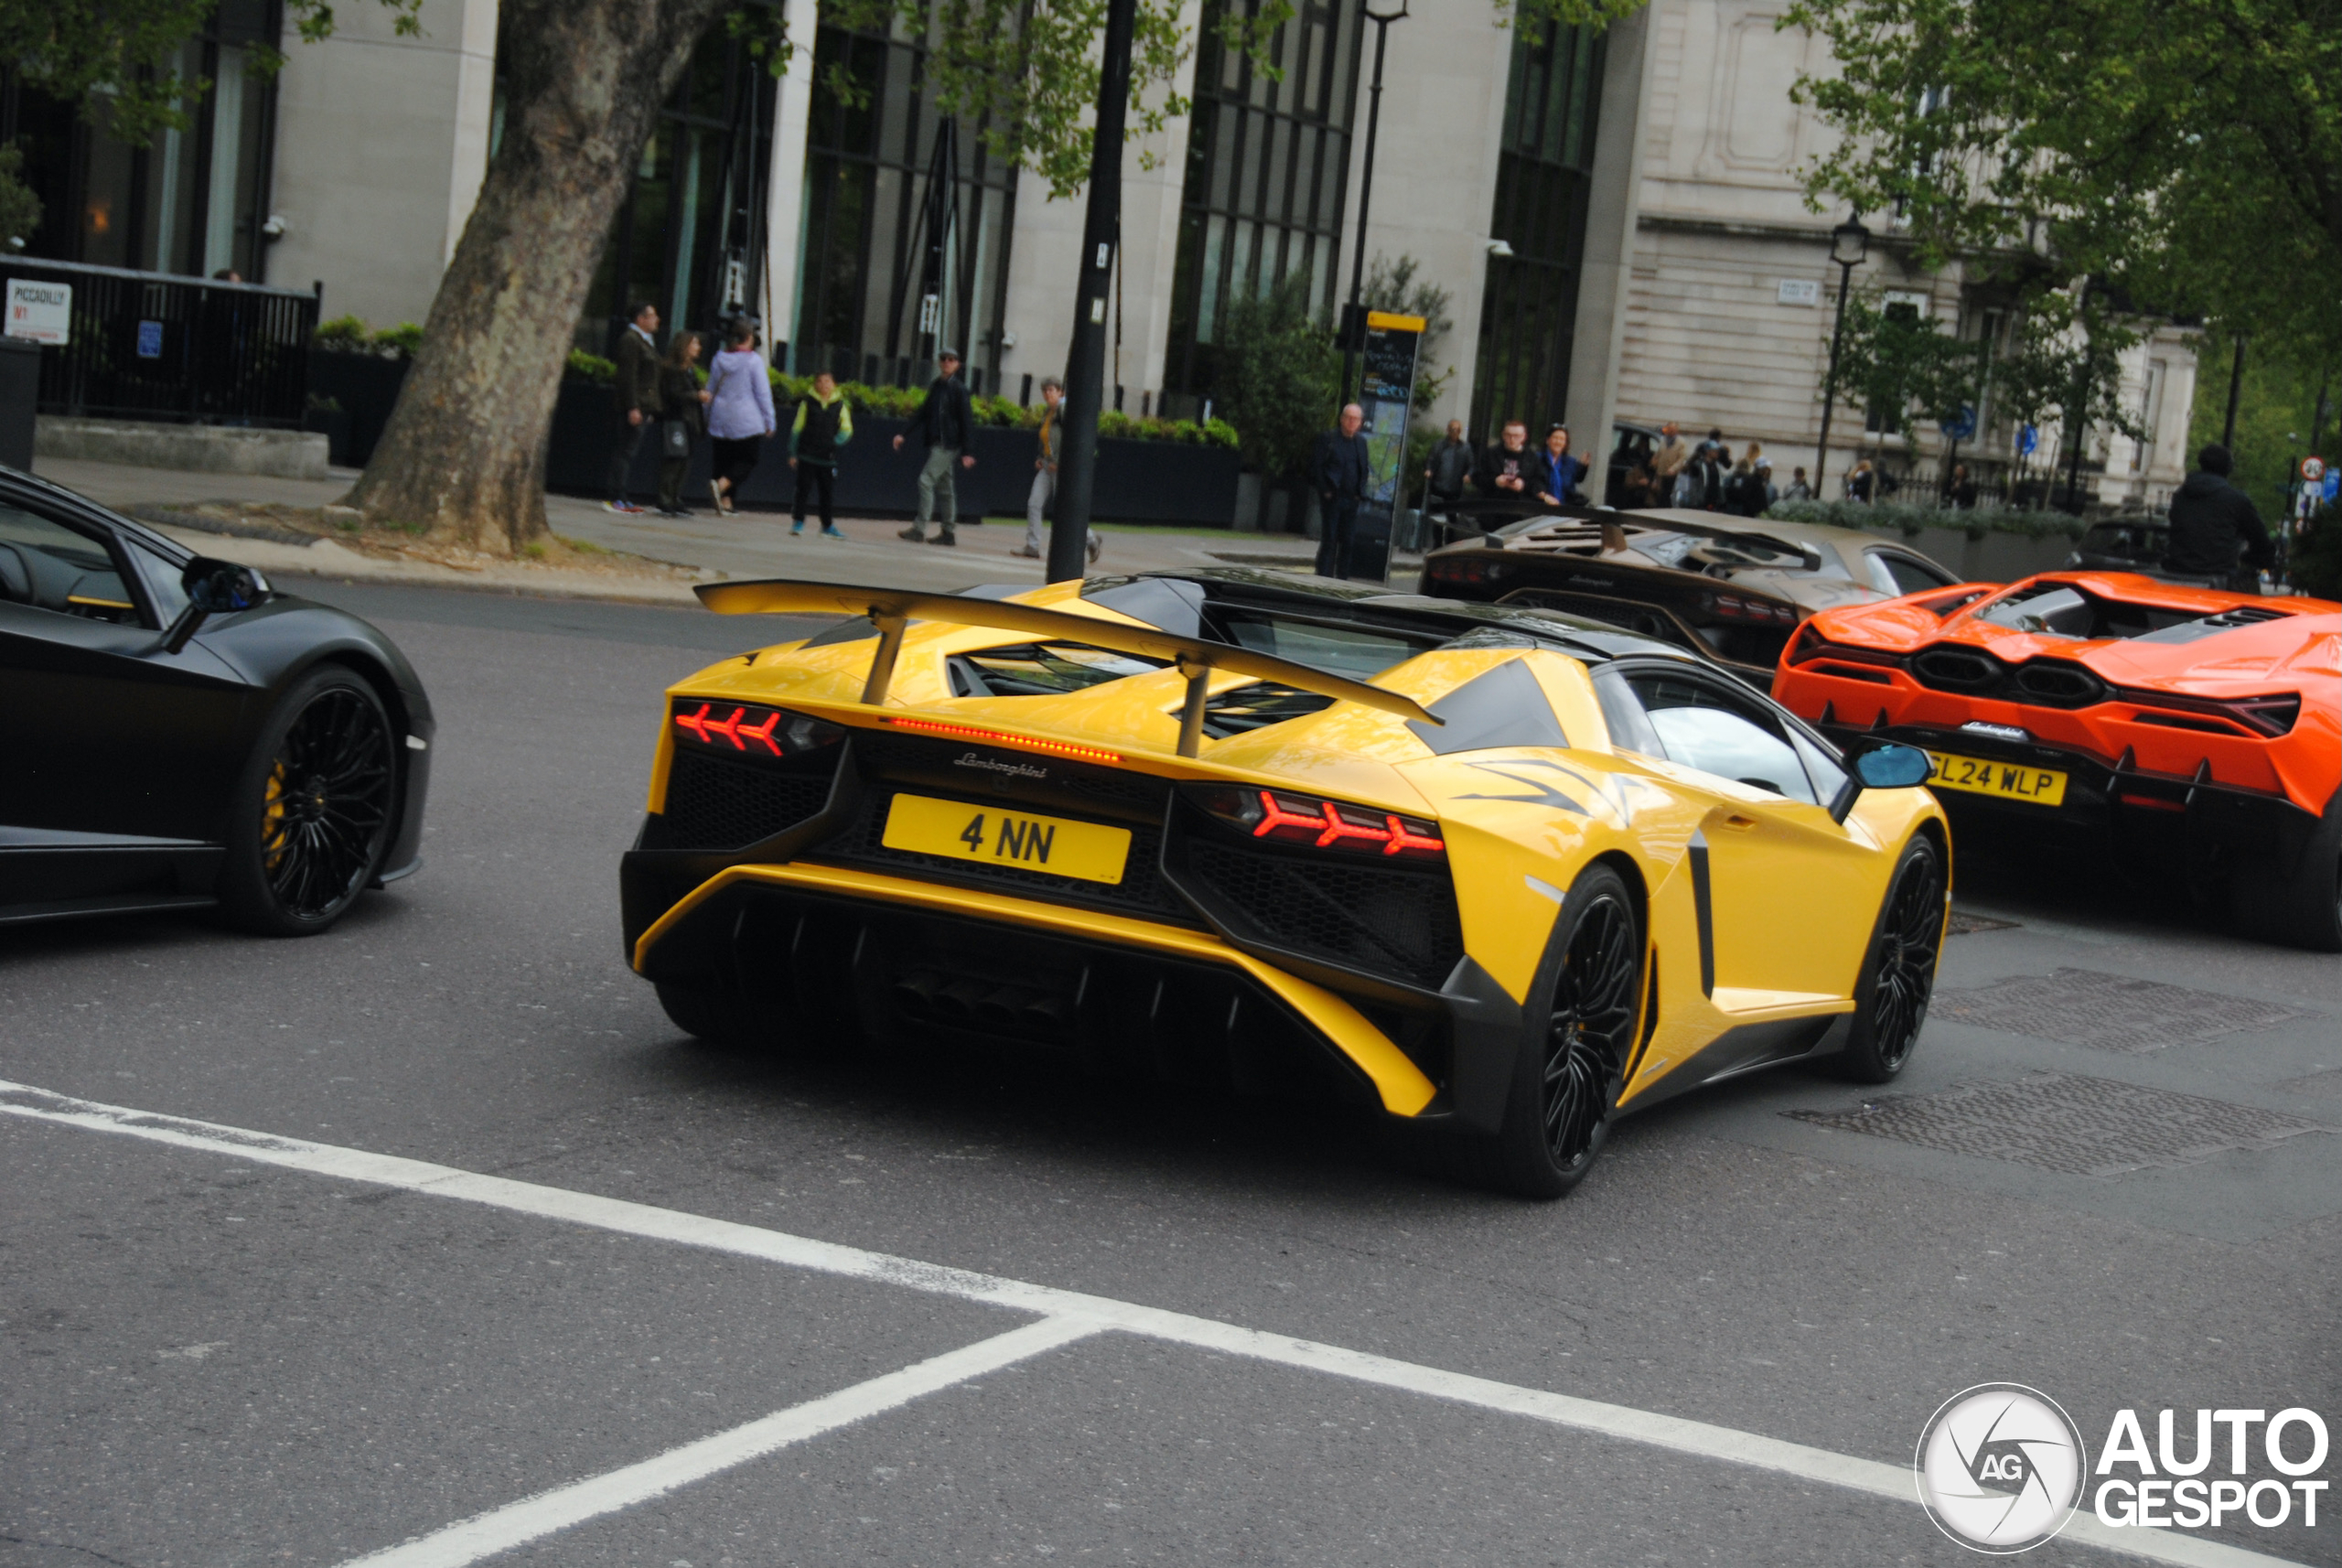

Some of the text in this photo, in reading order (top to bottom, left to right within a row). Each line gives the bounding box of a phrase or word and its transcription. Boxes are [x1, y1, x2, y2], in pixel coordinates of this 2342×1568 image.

[15, 287, 64, 306] PICCADILLY
[15, 306, 27, 320] W1
[953, 752, 1047, 778] Lamborghini
[2000, 768, 2053, 796] WLP
[960, 813, 1055, 864] 4 NN
